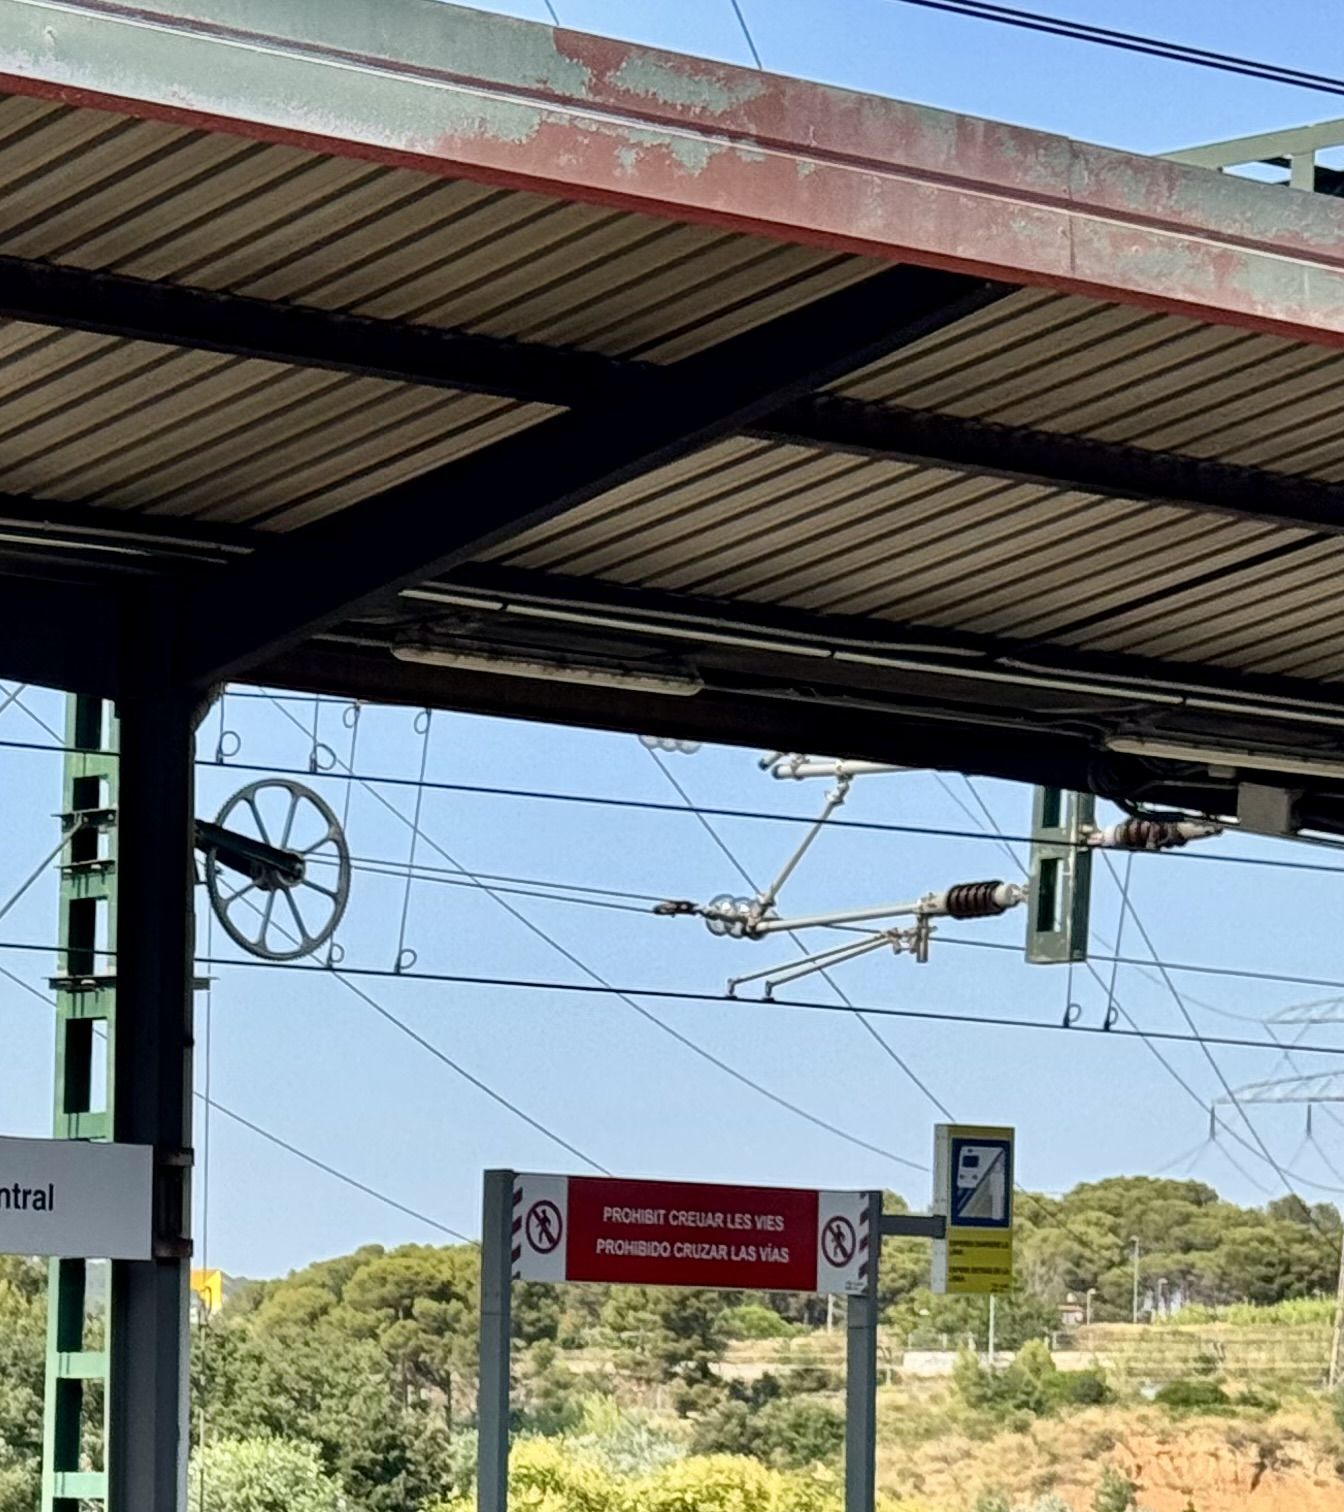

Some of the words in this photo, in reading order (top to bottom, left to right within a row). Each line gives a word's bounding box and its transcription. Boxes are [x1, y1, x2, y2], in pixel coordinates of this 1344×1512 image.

[602, 1206, 666, 1225] PROHIBIT
[668, 1209, 725, 1229] CREUAR
[727, 1213, 752, 1230] LES
[754, 1214, 785, 1232] VIES
[595, 1237, 671, 1259] PROHIBIDO
[673, 1241, 728, 1261] CRUZAR
[730, 1245, 757, 1263] LAS
[759, 1242, 790, 1264] VÍAS
